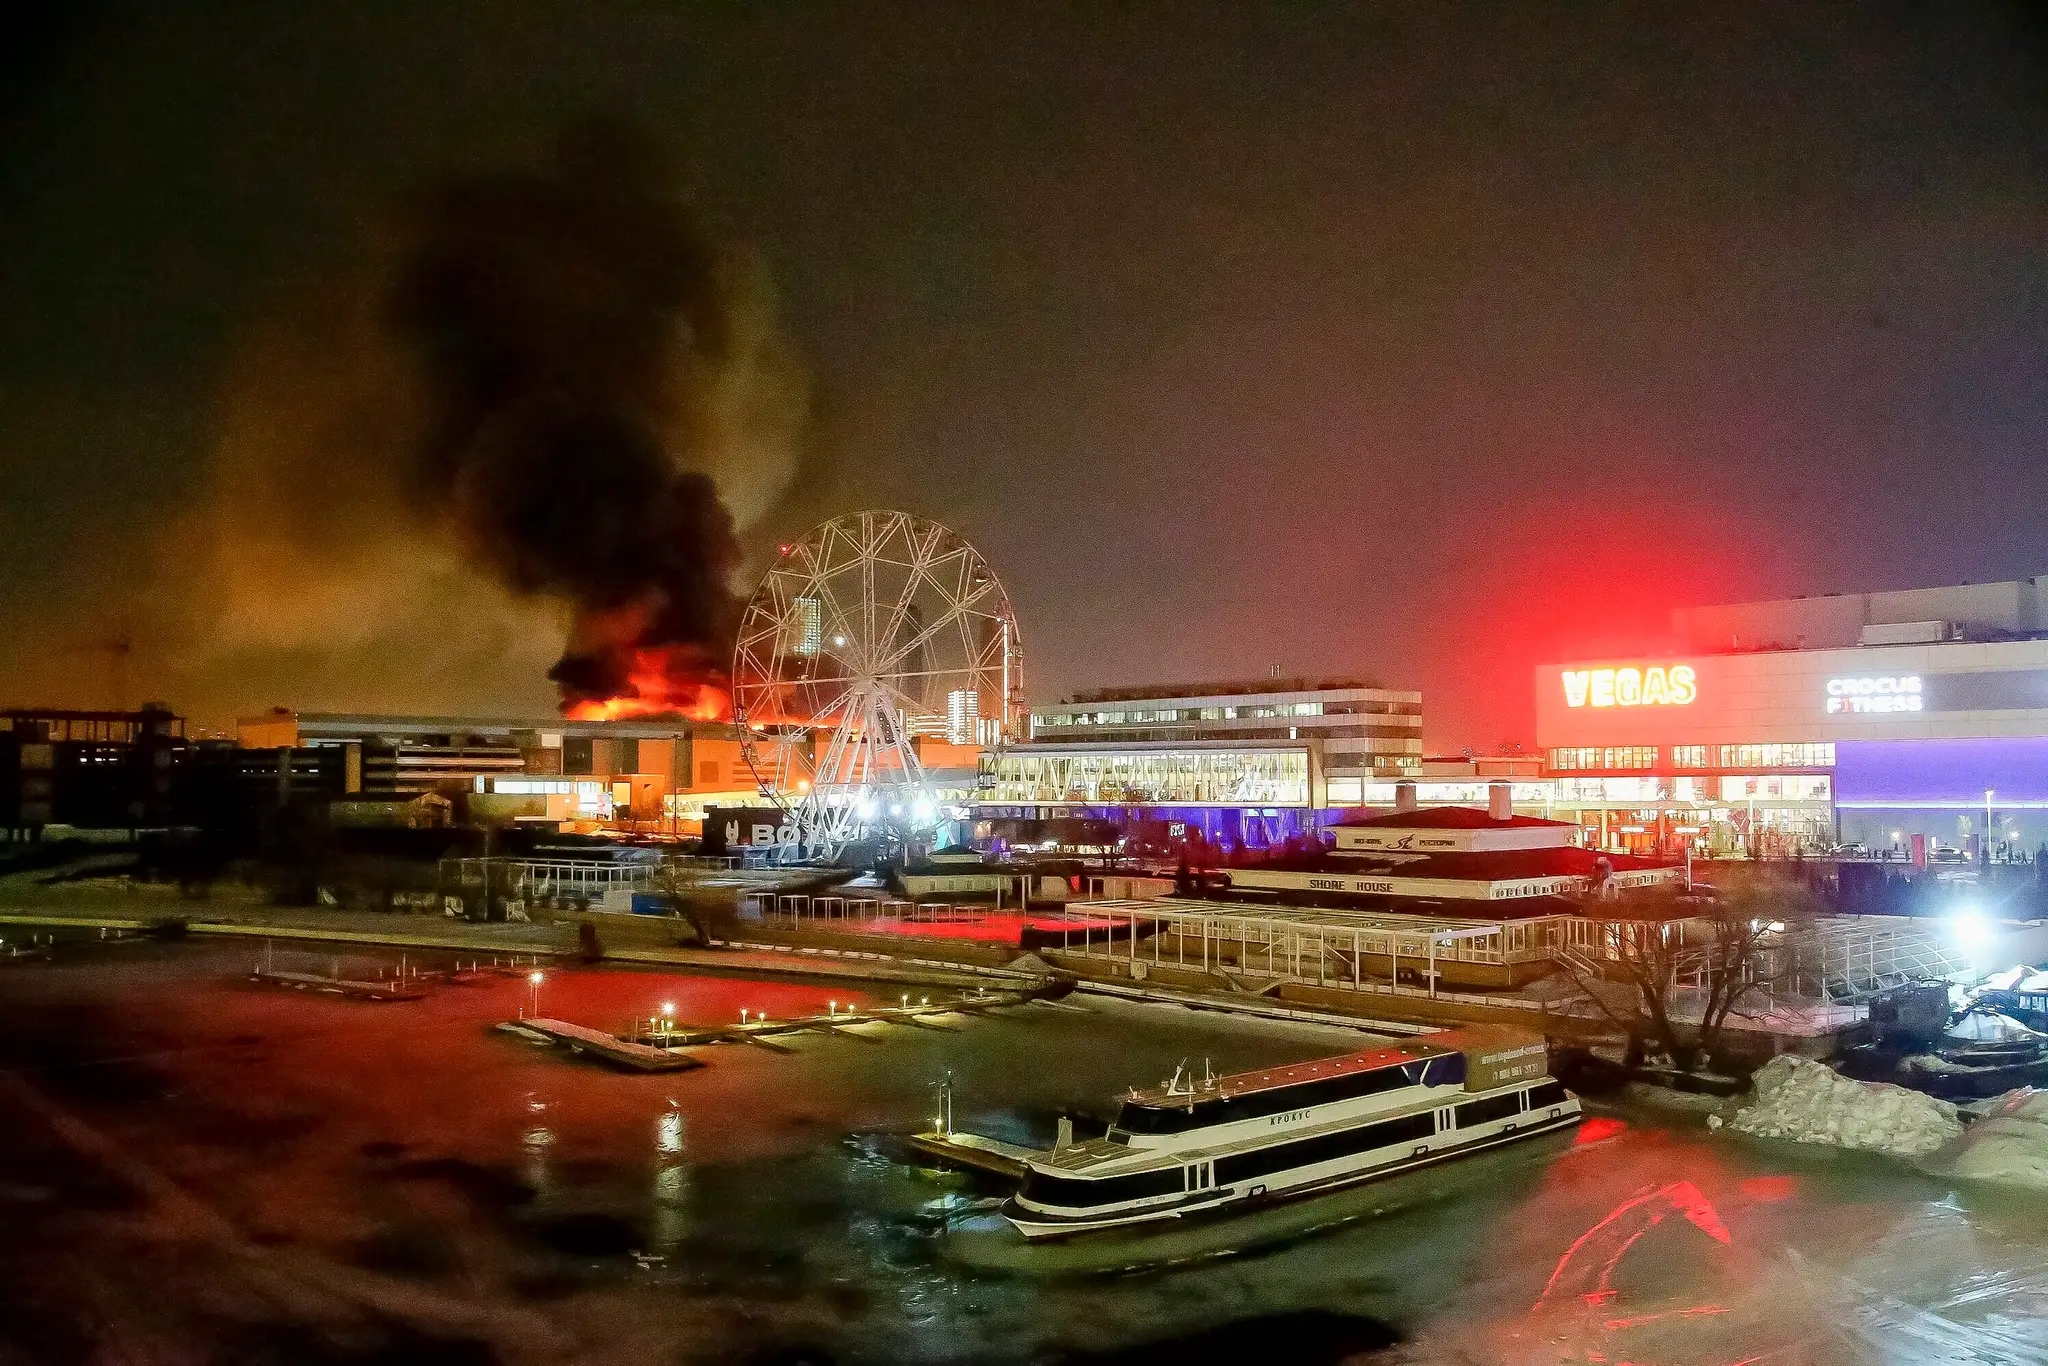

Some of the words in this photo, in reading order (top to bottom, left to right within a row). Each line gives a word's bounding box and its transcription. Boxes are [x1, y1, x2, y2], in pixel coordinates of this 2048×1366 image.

[1562, 665, 1697, 707] VEGAS
[1826, 676, 1922, 695] CROCUS
[1309, 879, 1345, 890] SHORE
[1356, 882, 1394, 893] HOUSE
[1270, 1110, 1311, 1126] КРОКУС
